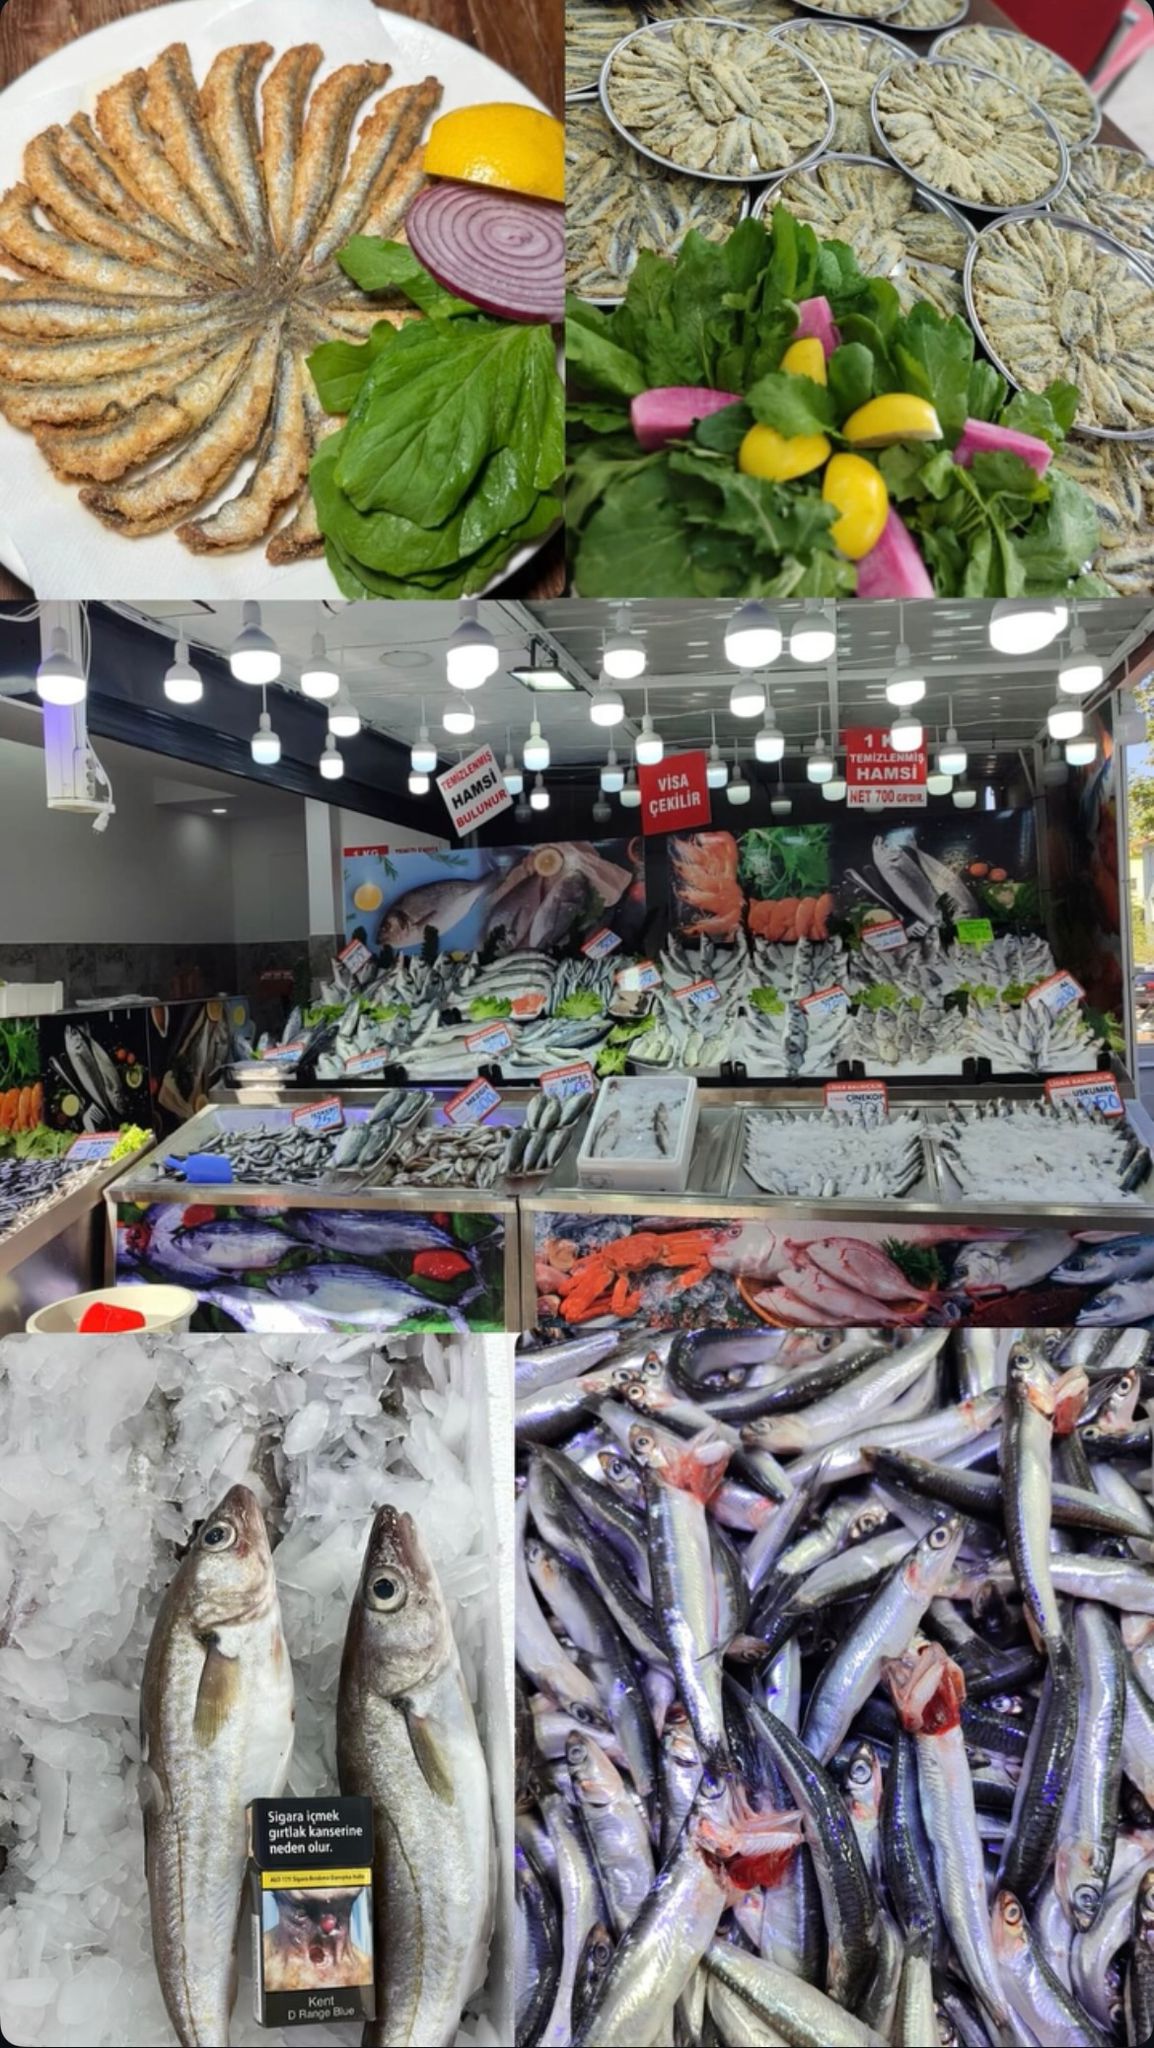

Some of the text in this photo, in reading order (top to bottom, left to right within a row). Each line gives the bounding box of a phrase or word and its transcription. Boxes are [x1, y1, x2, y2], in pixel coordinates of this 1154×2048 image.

[864, 733, 873, 749] 1
[849, 751, 925, 765] TEMİZLENMİŞ
[440, 750, 493, 791] TEMİZLENMİŞ
[857, 763, 918, 781] HAMSİ
[451, 767, 498, 810] HAMSİ
[657, 773, 689, 792] VİSA
[649, 789, 702, 818] ÇEKİLİR
[850, 789, 871, 804] NET
[875, 788, 895, 804] 700
[456, 788, 507, 829] BULUNUR
[1072, 1084, 1116, 1097] USKUMRU
[267, 1808, 340, 1826] Sigara içmek
[268, 1824, 363, 1842] gırtlak kanserine
[269, 1840, 333, 1855] neden olur.
[308, 1996, 335, 2008] Kent
[287, 2006, 355, 2020] D Range Blue
